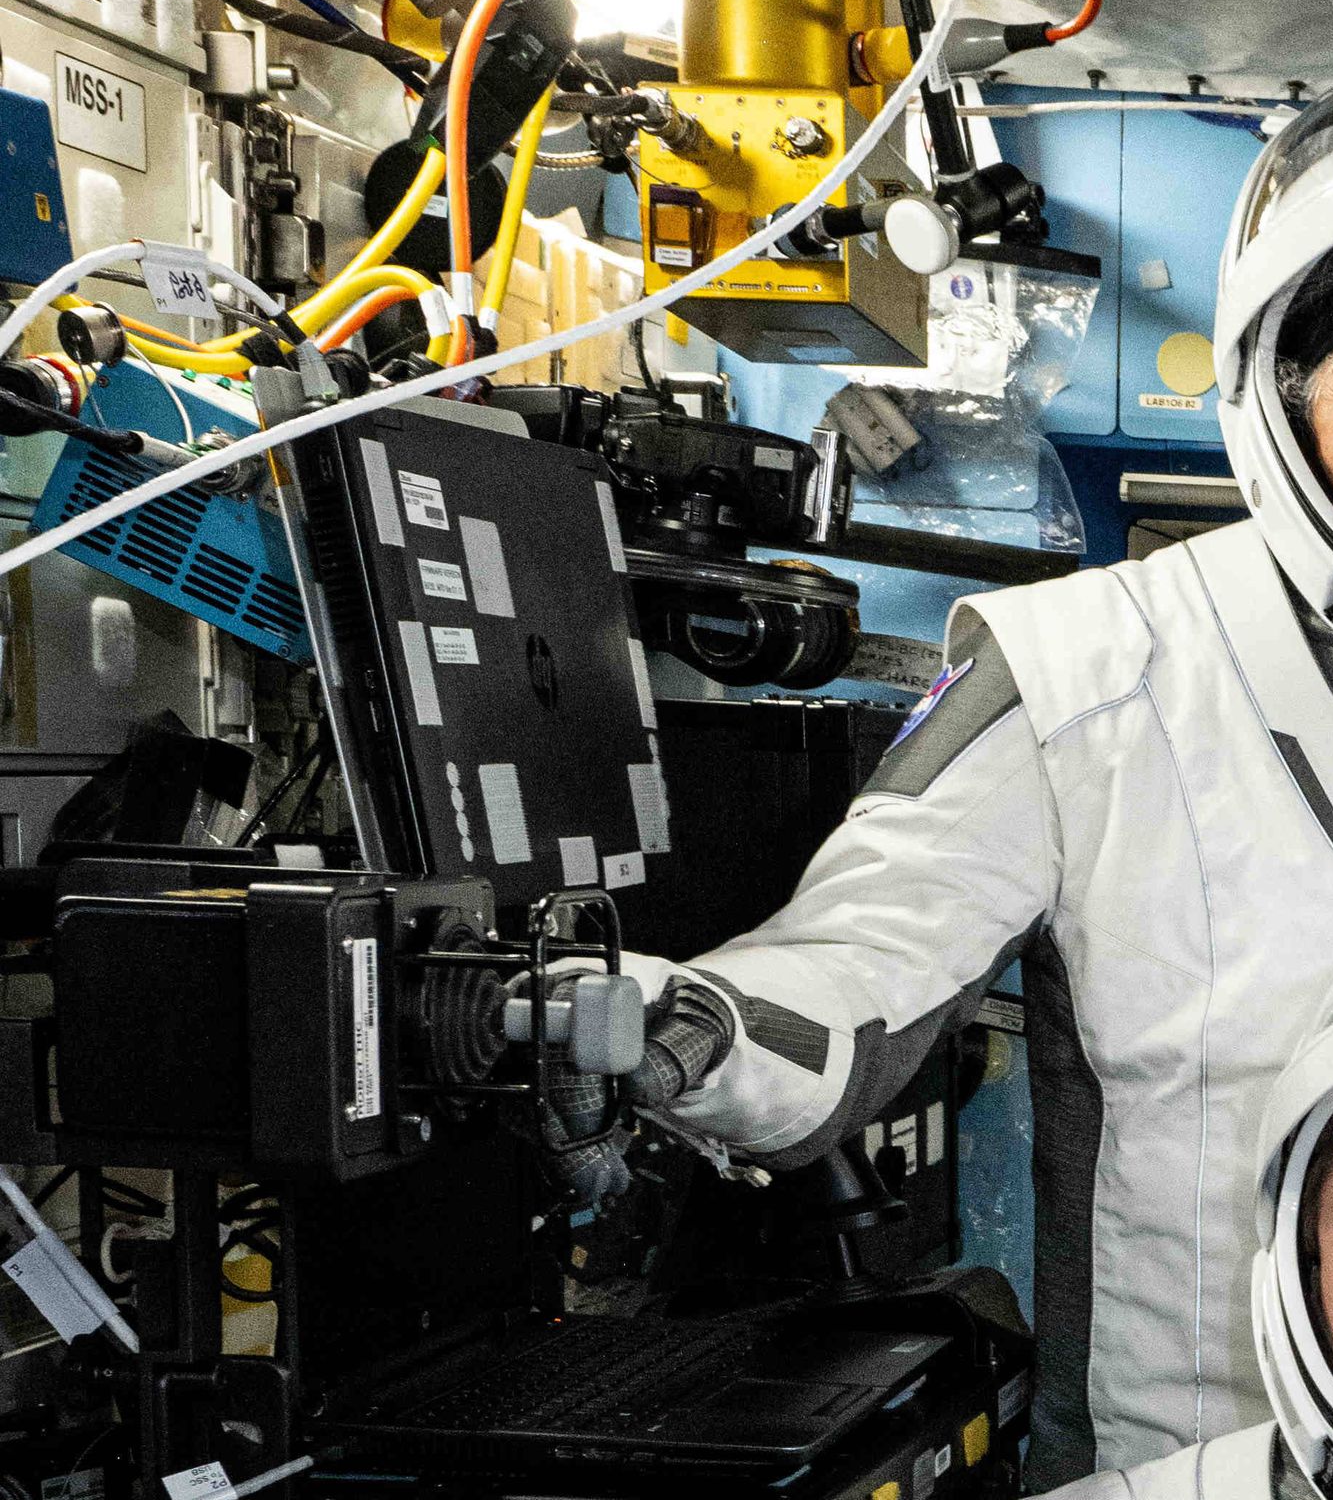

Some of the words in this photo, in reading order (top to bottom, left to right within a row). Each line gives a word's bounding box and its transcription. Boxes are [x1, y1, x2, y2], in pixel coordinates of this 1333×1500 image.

[65, 65, 122, 122] MSS-1
[8, 1262, 23, 1278] P1
[190, 1462, 212, 1477] USB
[209, 1469, 222, 1480] To
[189, 1473, 209, 1487] SSC
[210, 1477, 228, 1490] P2
